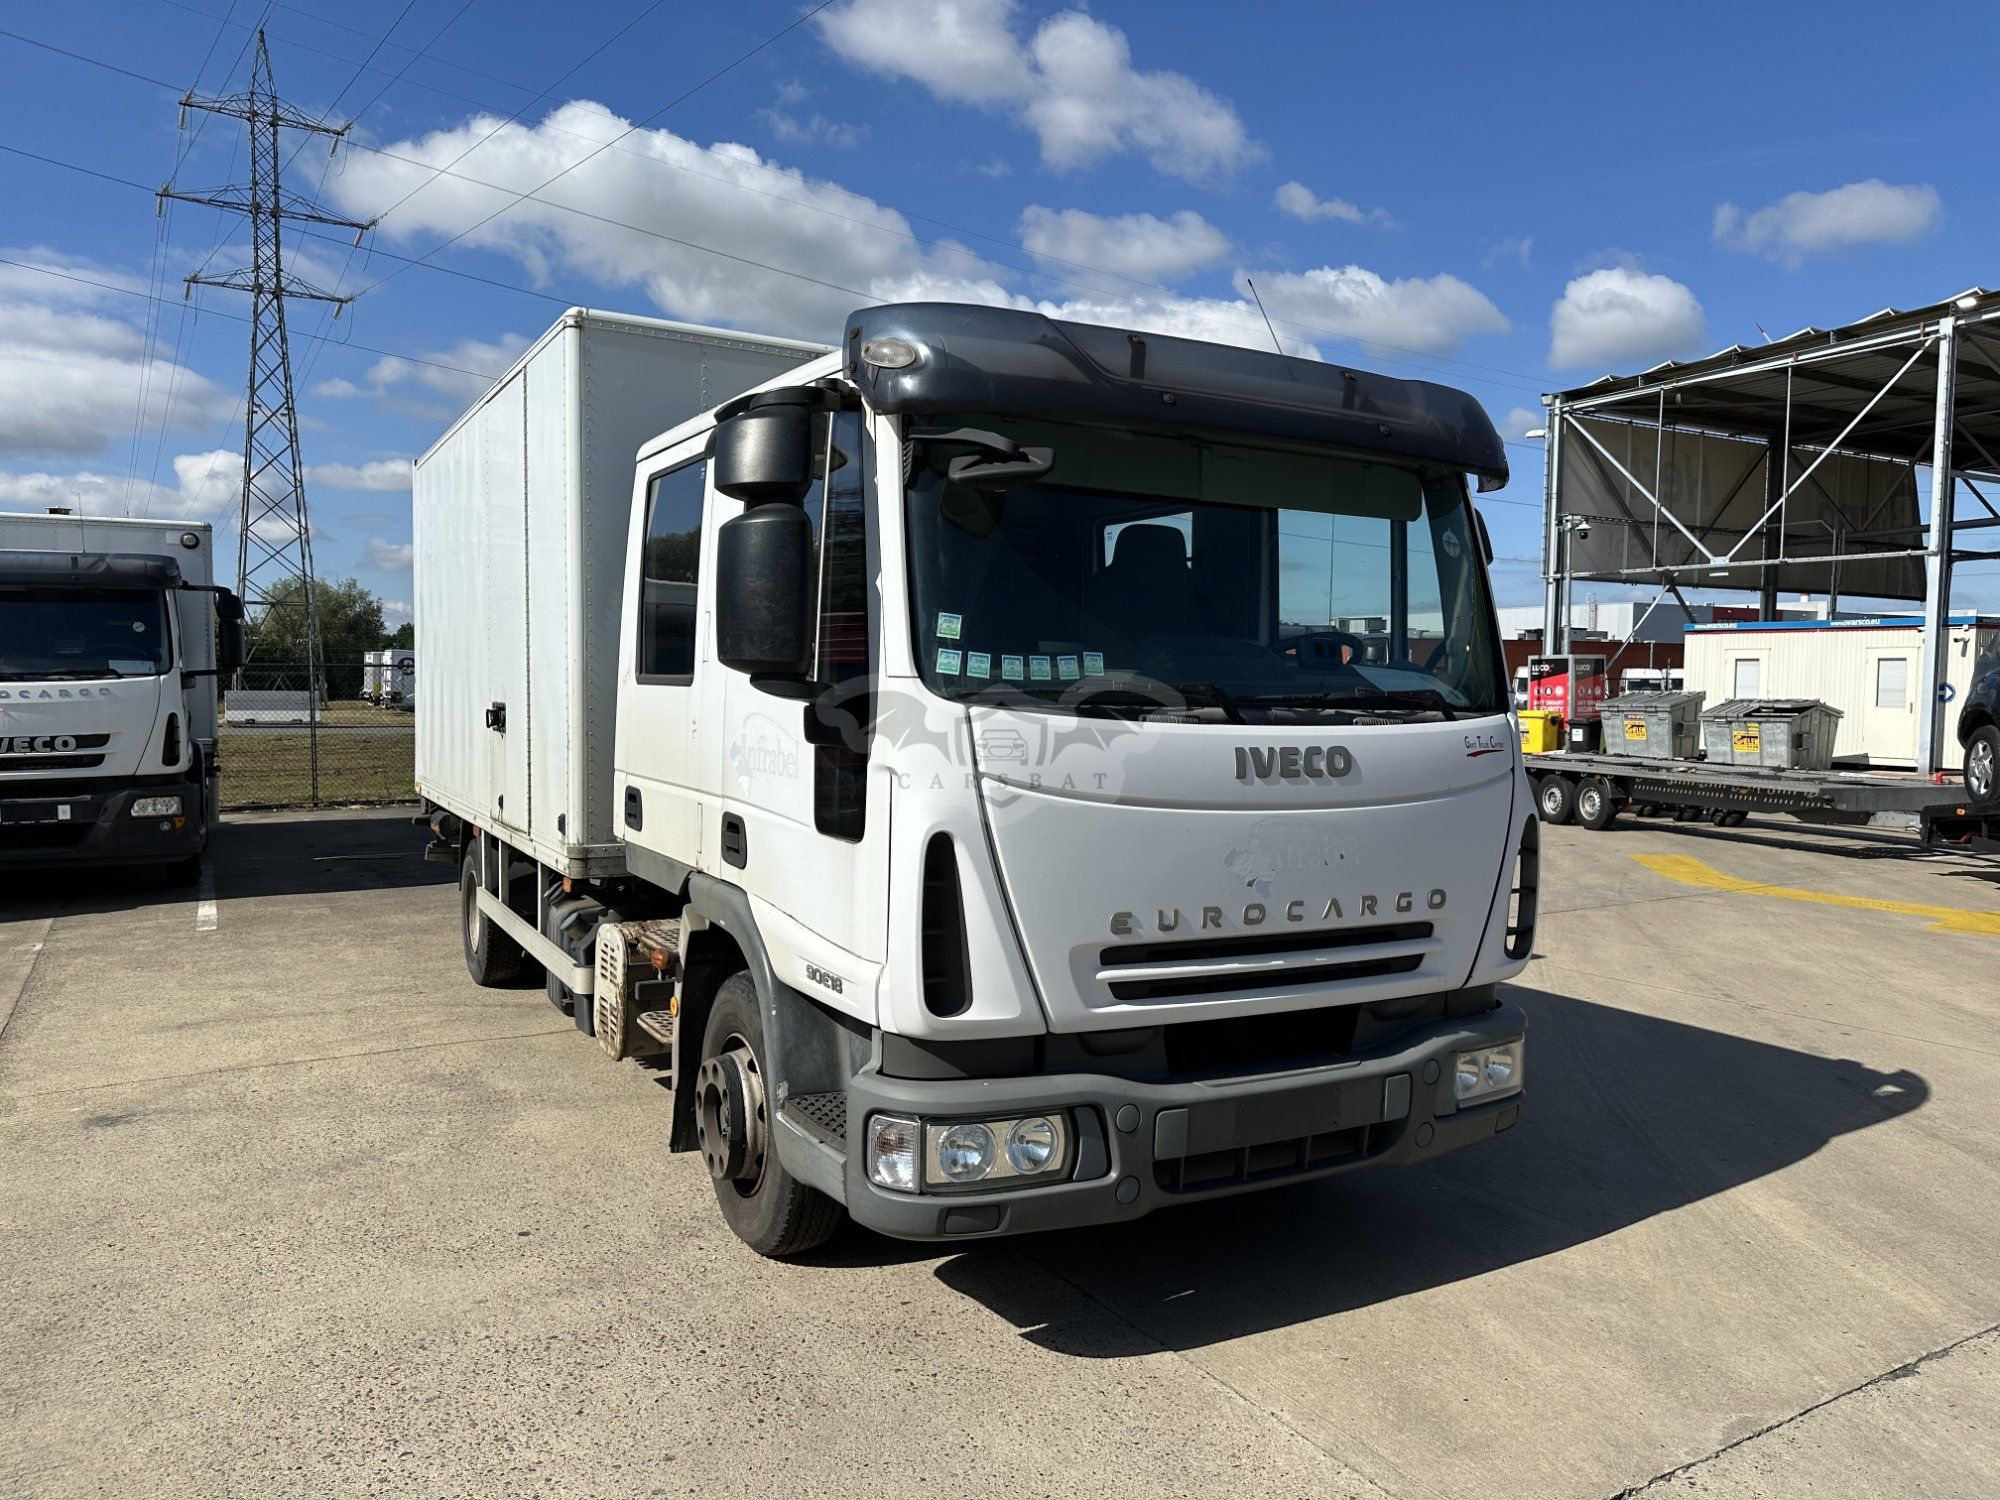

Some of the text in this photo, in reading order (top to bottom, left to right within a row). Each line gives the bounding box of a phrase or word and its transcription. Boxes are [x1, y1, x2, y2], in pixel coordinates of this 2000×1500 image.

[1830, 618, 1881, 627] www.warsco.eu
[1235, 745, 1352, 779] IVECO
[1109, 888, 1447, 936] EUROCARGO
